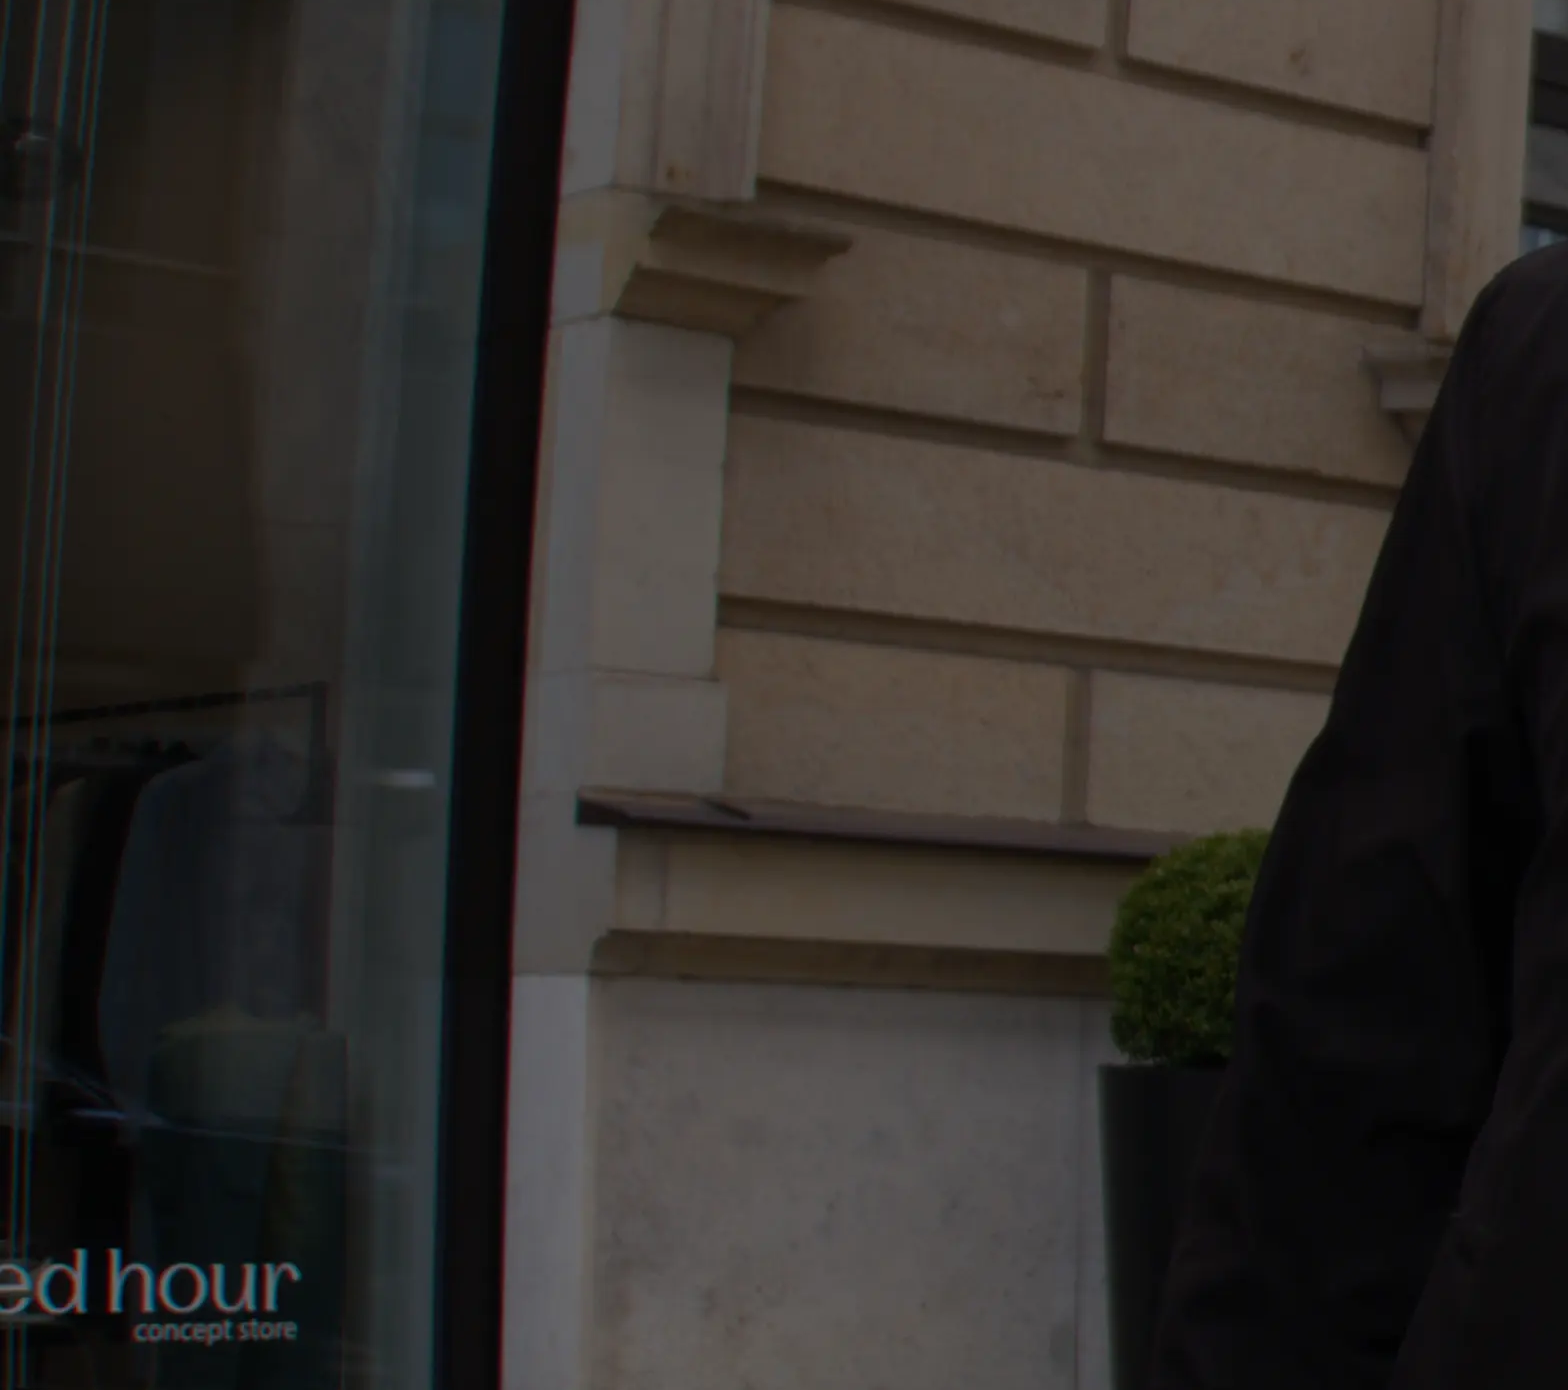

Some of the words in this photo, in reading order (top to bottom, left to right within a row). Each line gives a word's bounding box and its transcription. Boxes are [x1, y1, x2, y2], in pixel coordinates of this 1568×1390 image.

[106, 1248, 302, 1314] hour
[132, 1319, 232, 1347] concept
[238, 1319, 298, 1341] store
